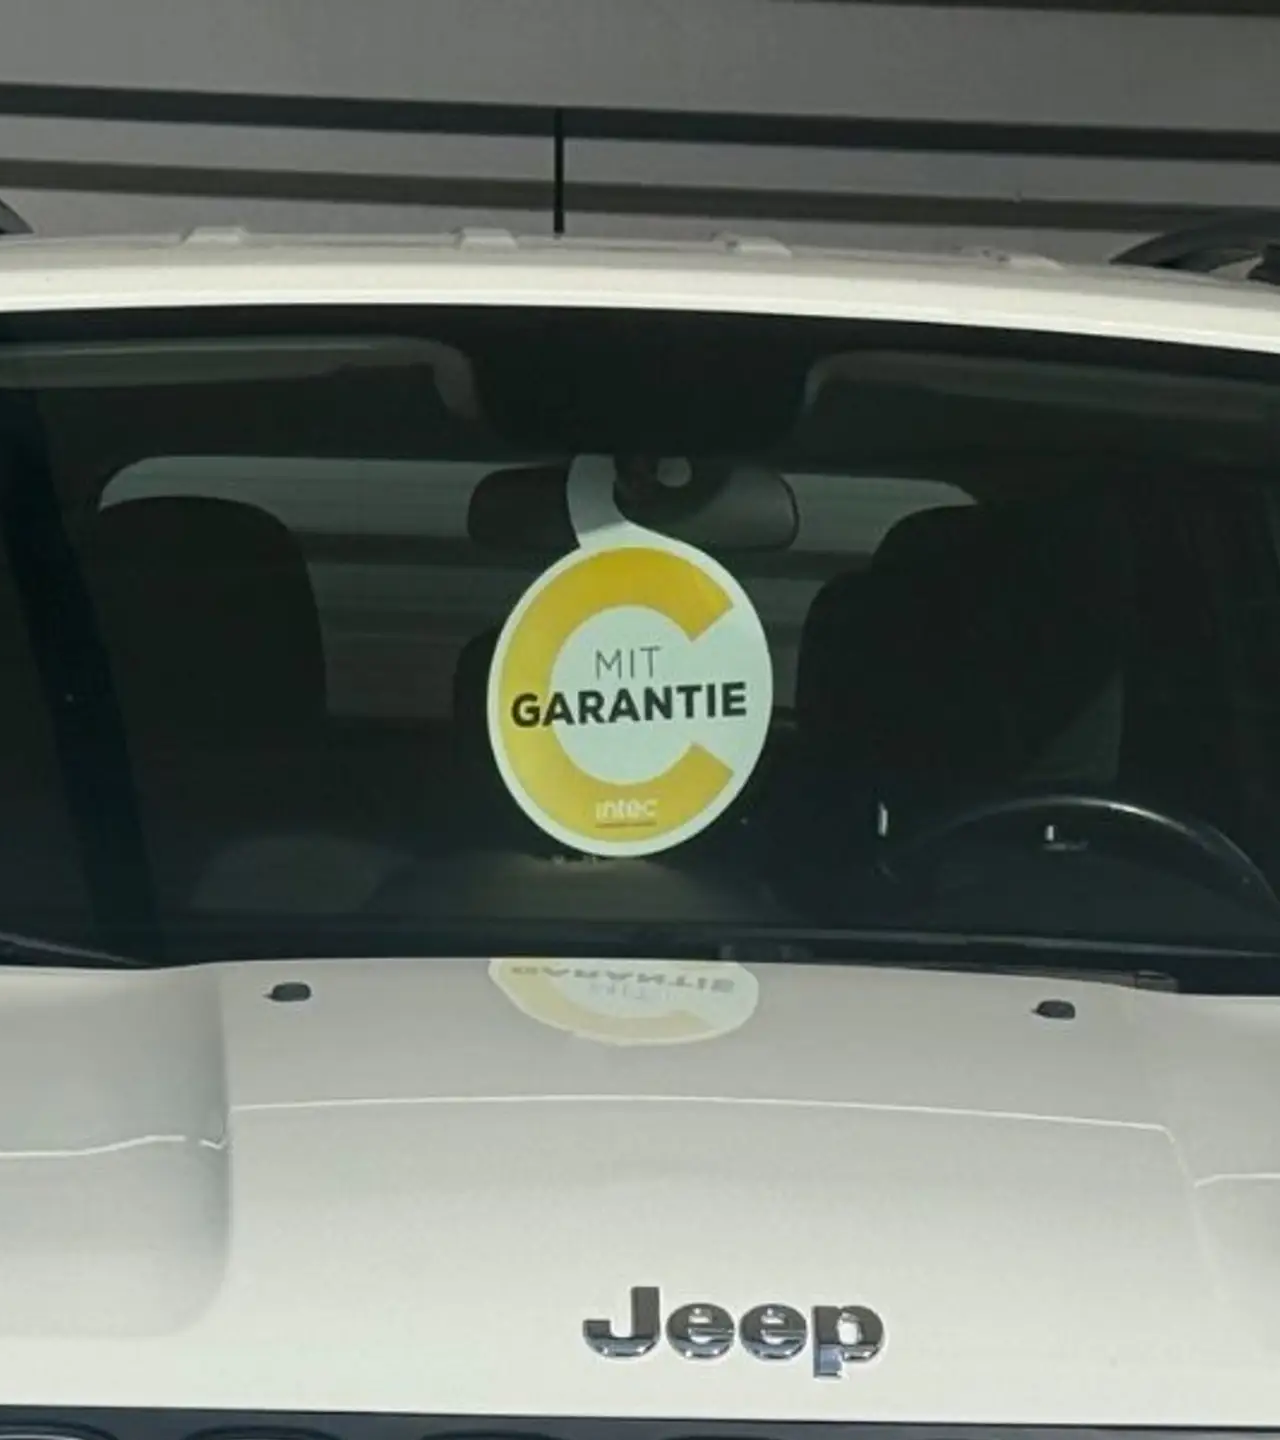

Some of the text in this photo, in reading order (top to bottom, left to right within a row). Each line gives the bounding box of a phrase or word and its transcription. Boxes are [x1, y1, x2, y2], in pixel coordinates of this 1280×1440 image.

[595, 646, 661, 680] MIT
[511, 682, 747, 728] GARANTIE
[582, 1286, 884, 1377] Jeep
